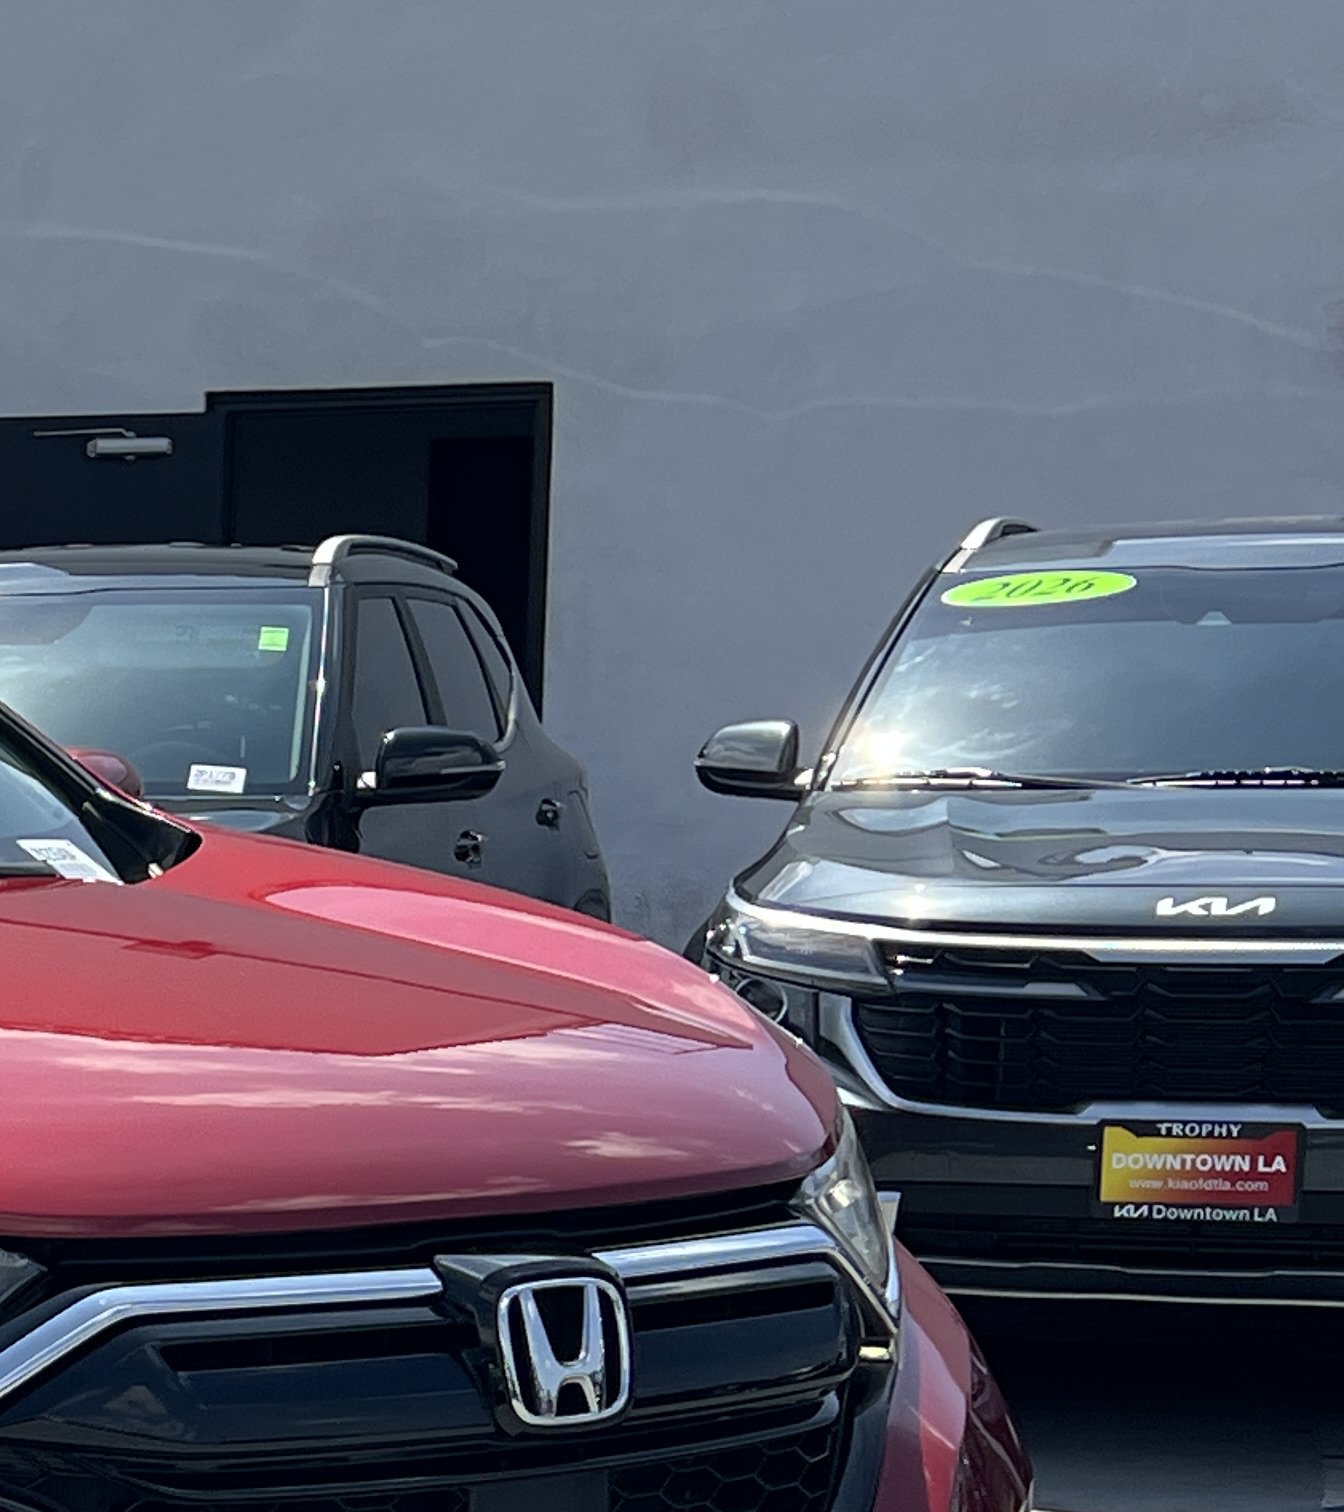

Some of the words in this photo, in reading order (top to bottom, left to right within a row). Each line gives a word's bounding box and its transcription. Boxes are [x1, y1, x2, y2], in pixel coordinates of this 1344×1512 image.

[972, 577, 1096, 601] 2026
[1155, 896, 1277, 917] KIA
[1157, 1122, 1242, 1138] TROPHY
[1111, 1154, 1250, 1172] DOWNTOWN
[1257, 1155, 1287, 1174] LA
[1128, 1177, 1269, 1193] www.kiaofdtla.com
[1113, 1205, 1149, 1218] KIA
[1152, 1205, 1250, 1222] Downtown
[1254, 1207, 1277, 1223] LA
